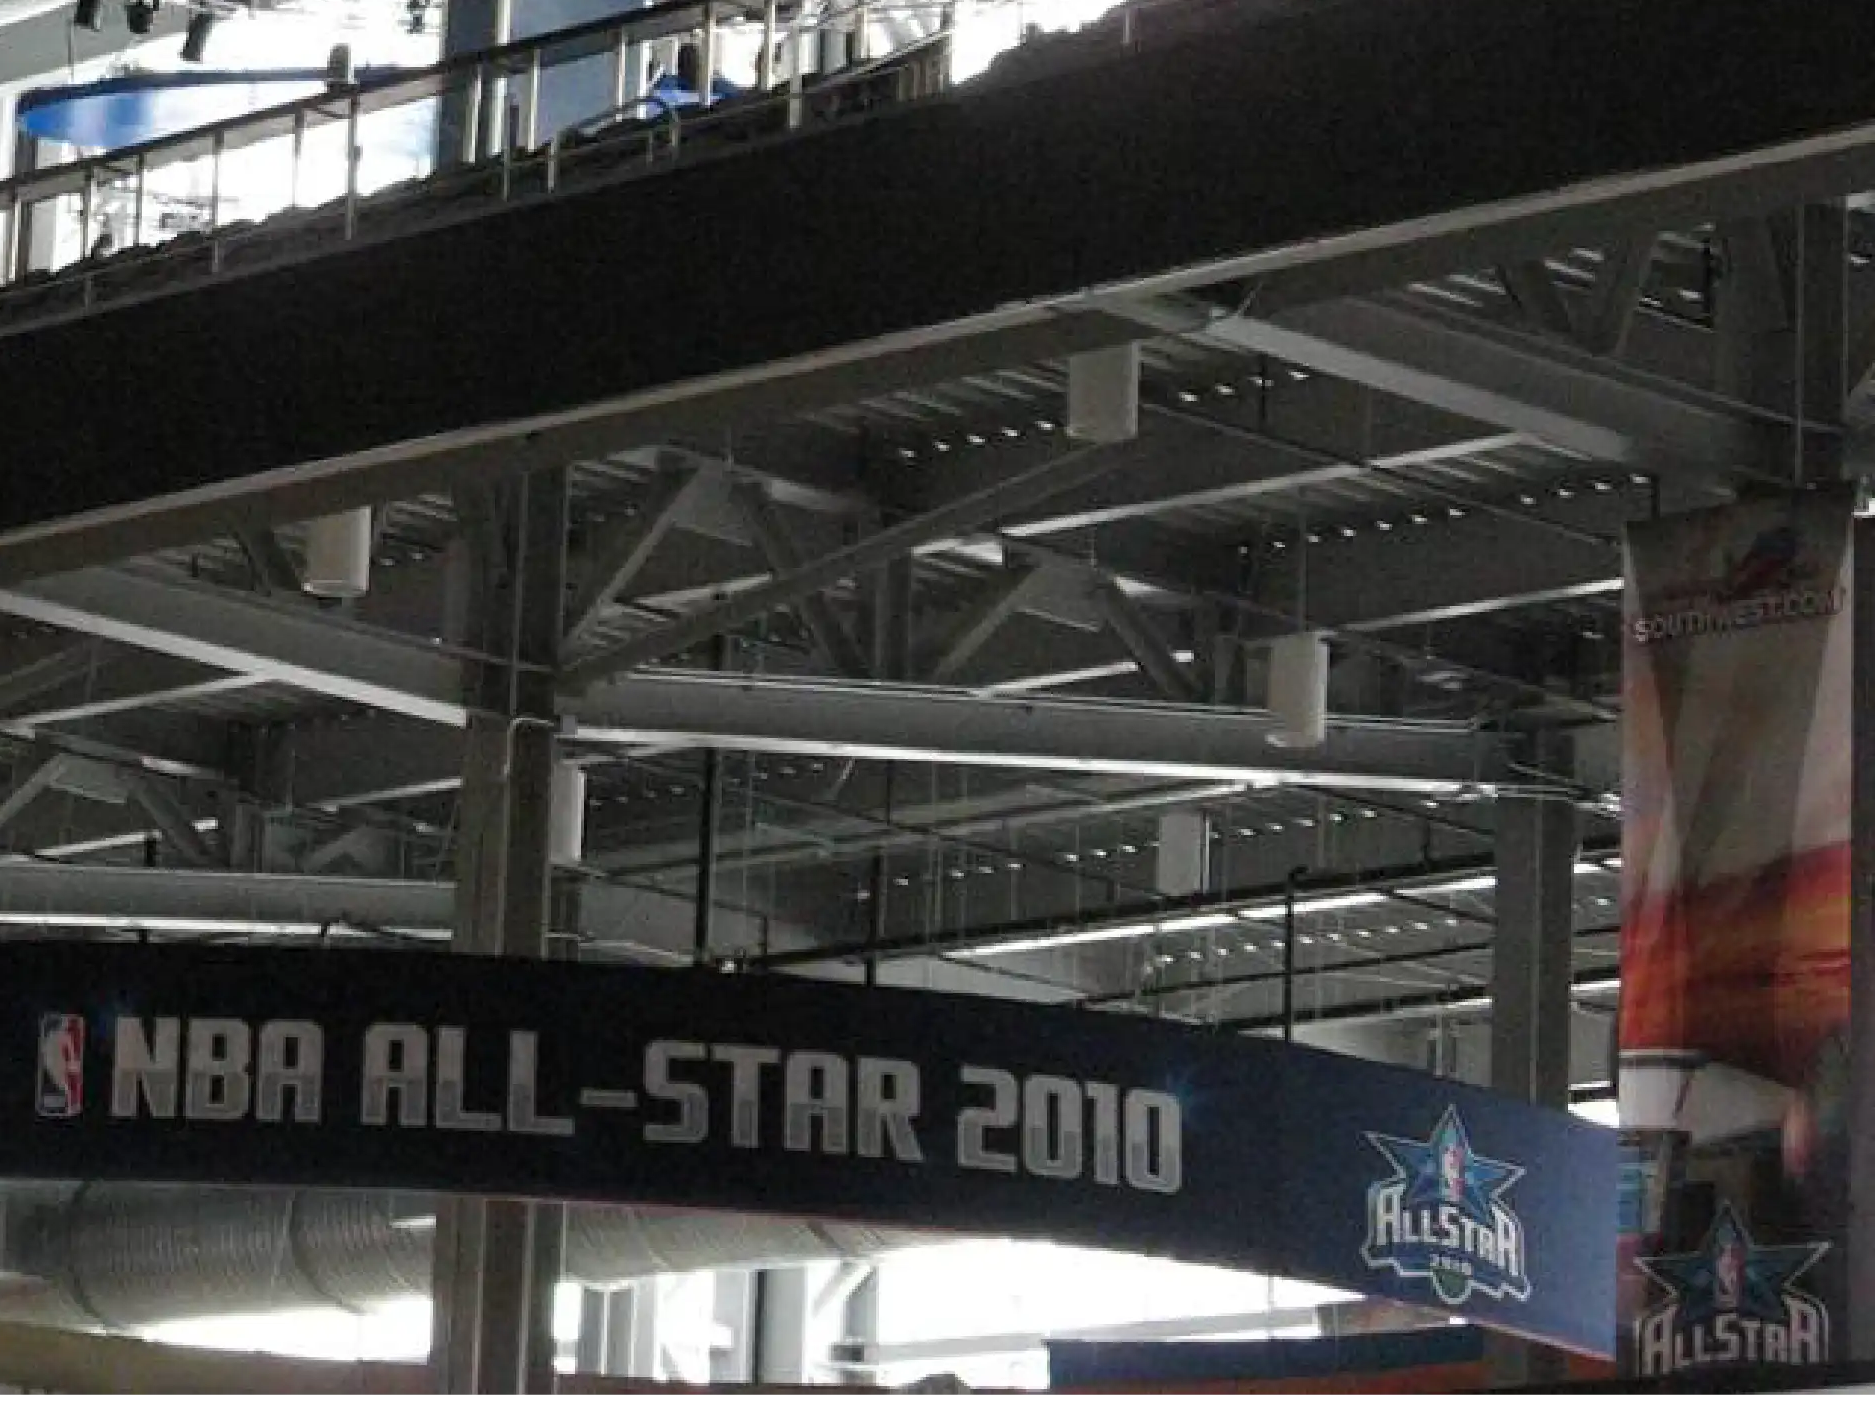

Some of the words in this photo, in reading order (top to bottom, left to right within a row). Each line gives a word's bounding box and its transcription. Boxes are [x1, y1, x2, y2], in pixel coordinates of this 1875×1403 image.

[110, 1016, 324, 1123] NBA
[360, 1022, 923, 1163] ALL-STAR
[957, 1064, 1183, 1195] 2010
